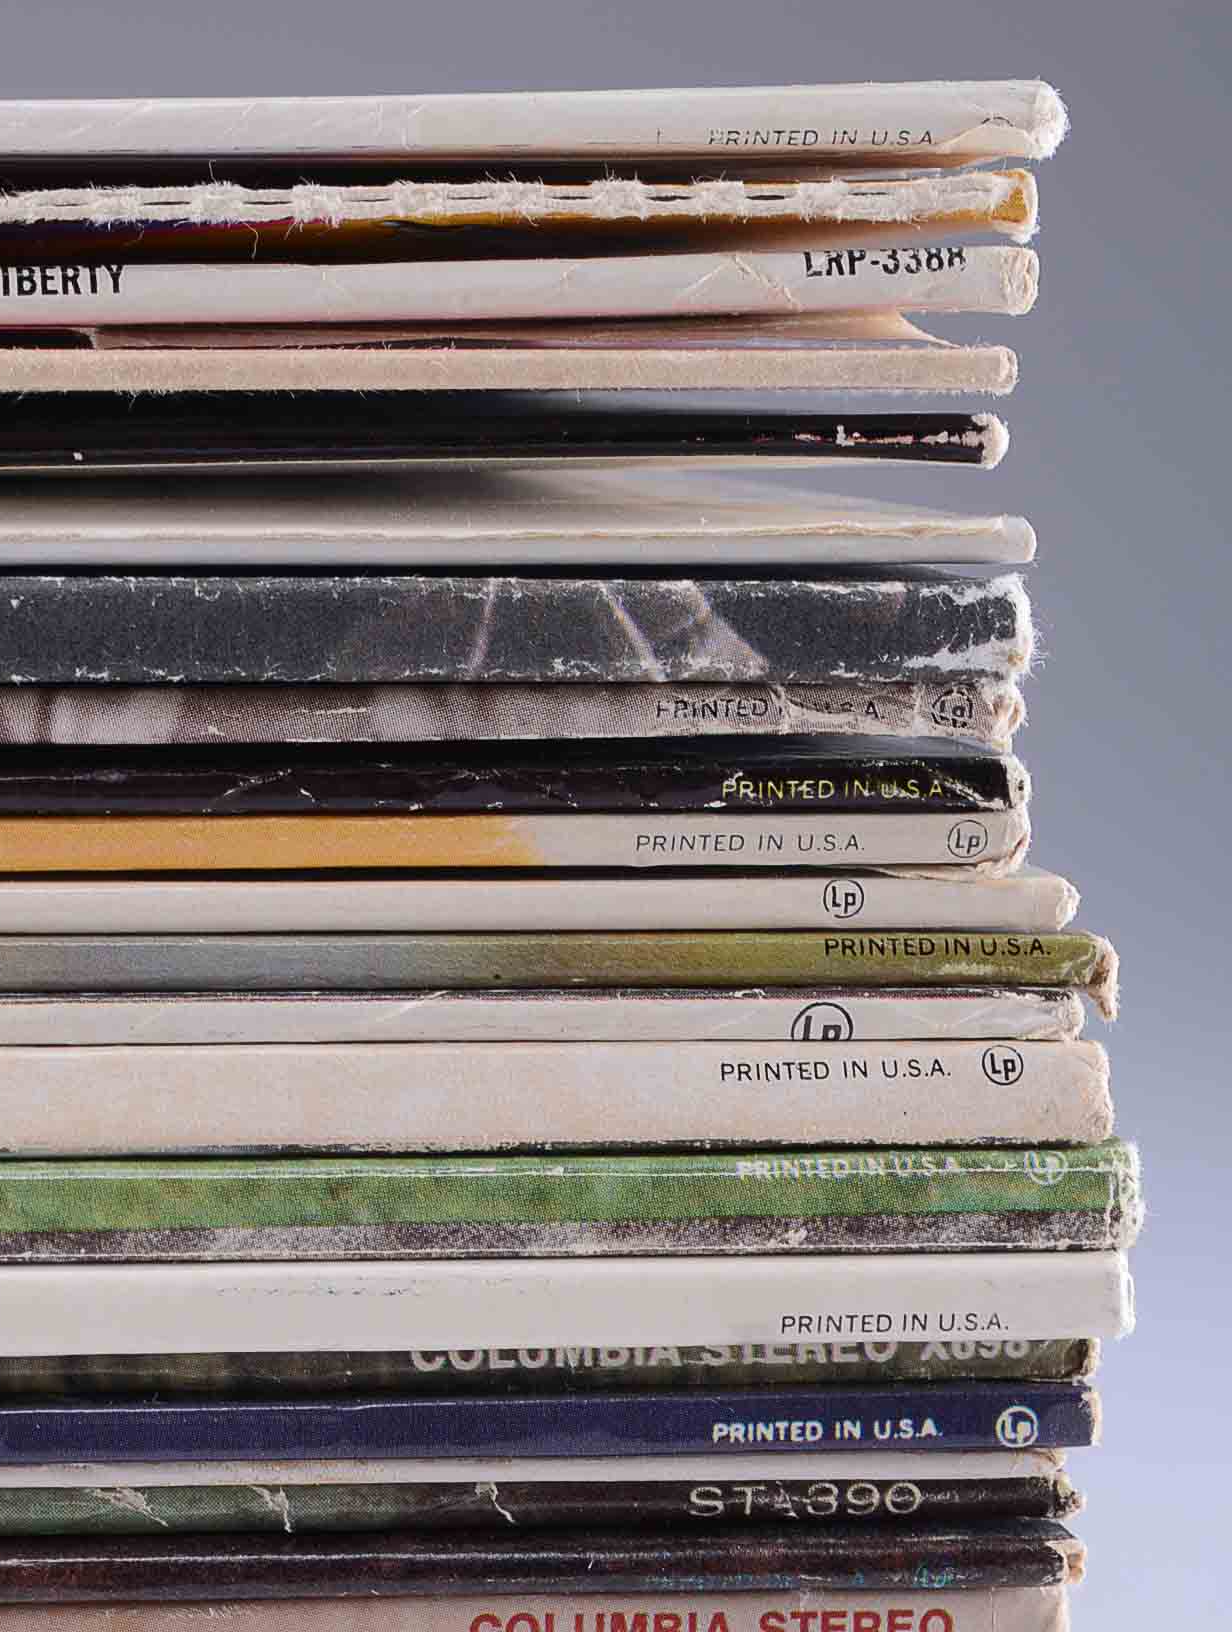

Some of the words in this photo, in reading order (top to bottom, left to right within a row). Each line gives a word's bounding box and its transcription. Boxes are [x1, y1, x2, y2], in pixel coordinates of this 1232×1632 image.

[831, 129, 859, 146] IN
[721, 778, 835, 800] PRINTED
[844, 779, 872, 797] IN
[635, 834, 746, 852] PRINTED
[757, 834, 784, 851] IN
[796, 834, 866, 852] U.S.A.
[824, 937, 936, 956] PRINTED
[945, 937, 971, 955] IN
[980, 937, 1052, 956] U.S.A.
[720, 1061, 830, 1082] PRINTED
[843, 1060, 868, 1079] IN
[881, 1059, 952, 1079] U.S.A.
[735, 1158, 851, 1181] PRINTED
[781, 1314, 893, 1334] PRINTED
[902, 1313, 929, 1332] IN
[939, 1312, 1009, 1332] U.S.A.
[712, 1420, 824, 1443] PRINTED
[834, 1419, 863, 1441] IN
[873, 1418, 943, 1440] U.S.A.
